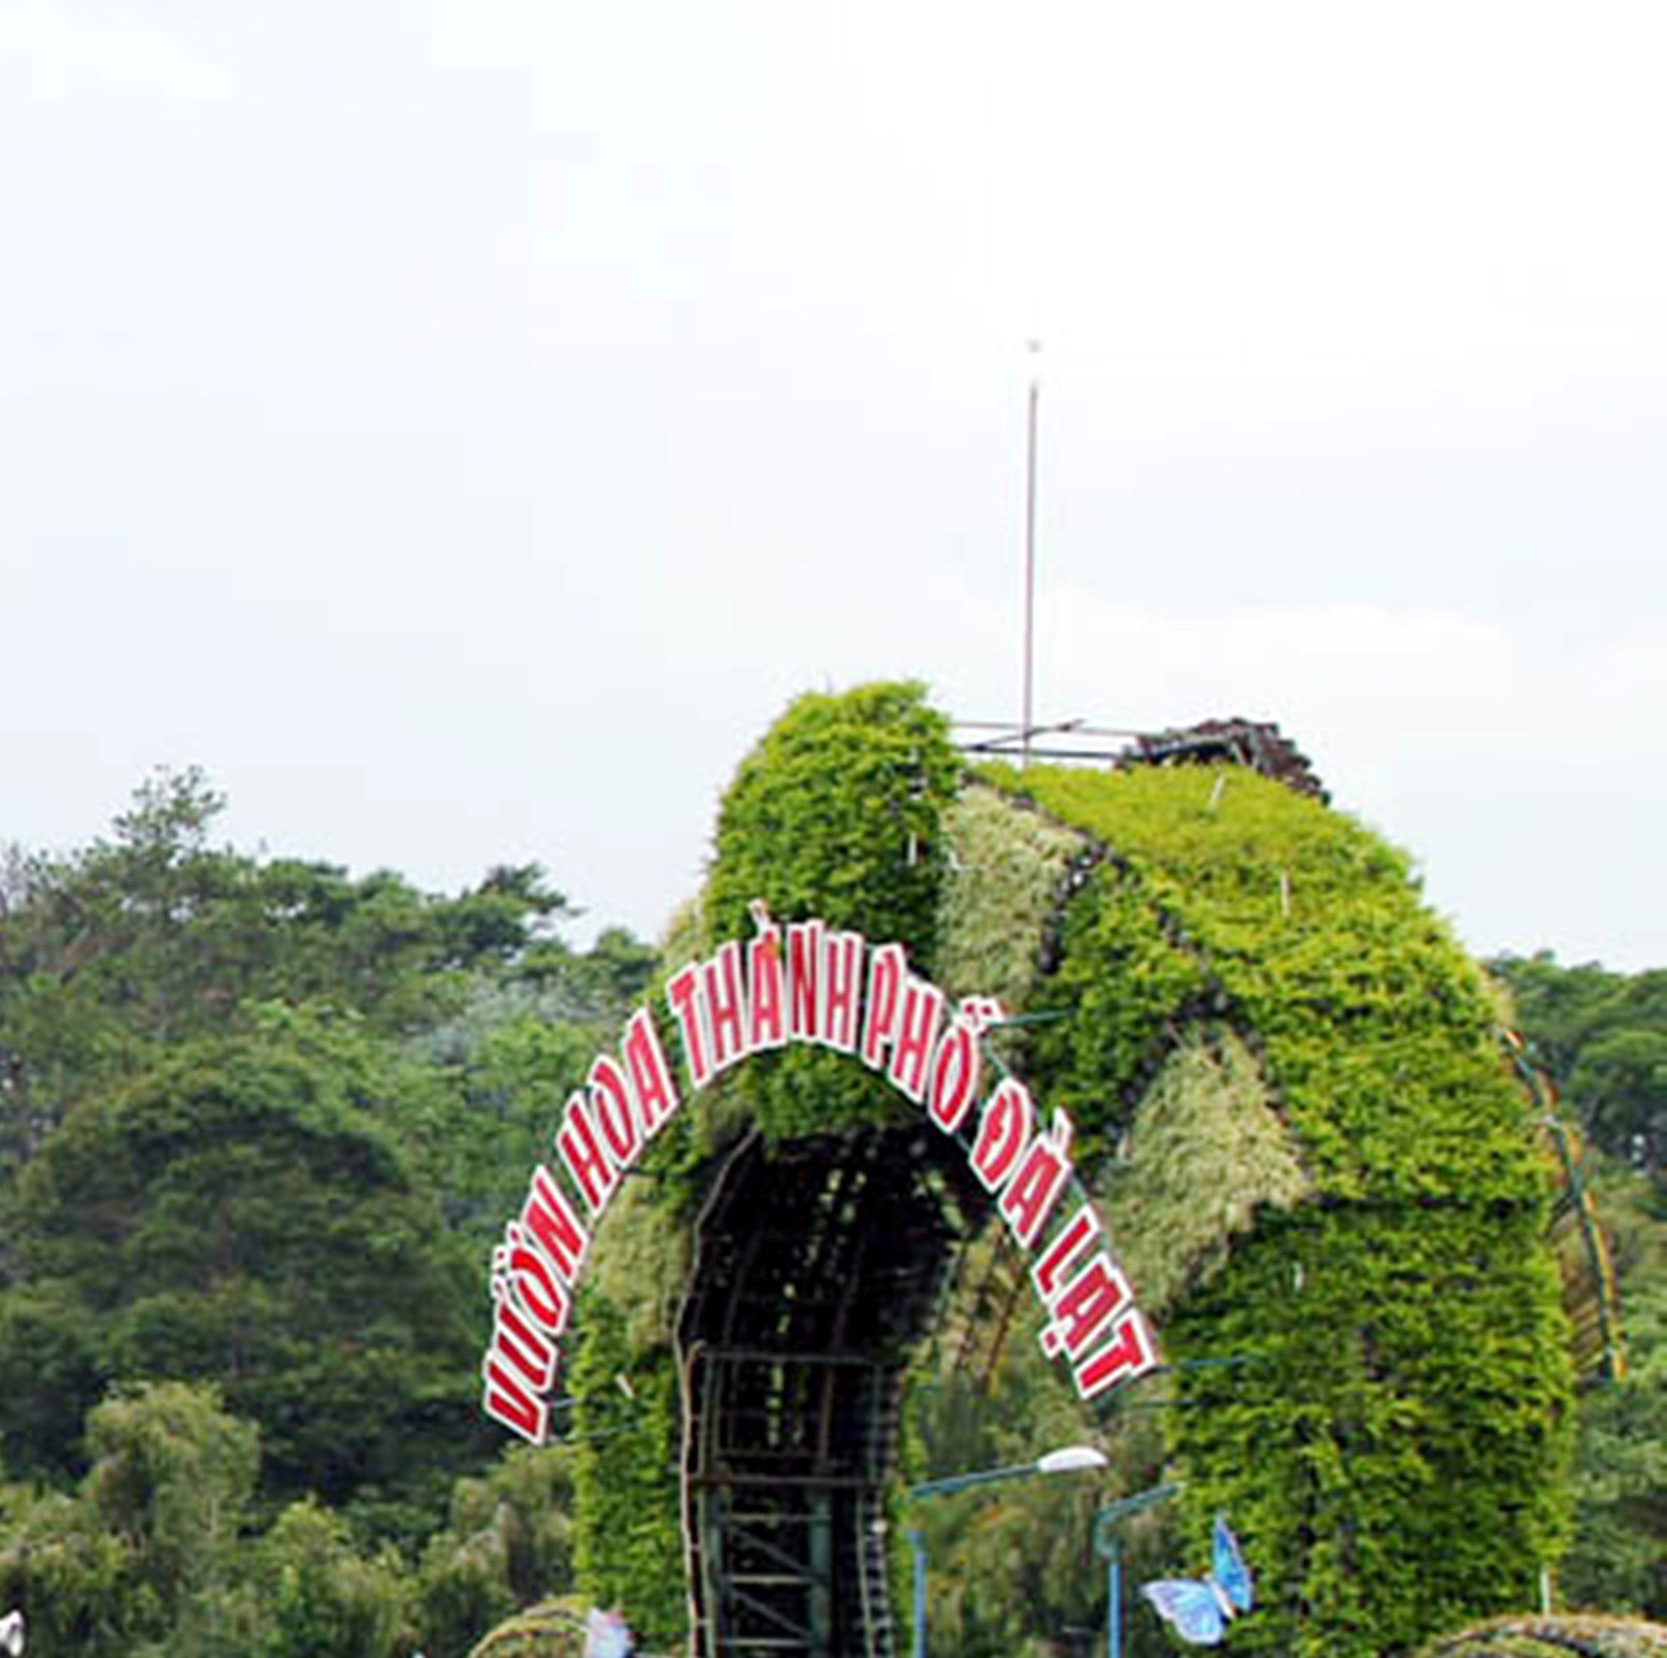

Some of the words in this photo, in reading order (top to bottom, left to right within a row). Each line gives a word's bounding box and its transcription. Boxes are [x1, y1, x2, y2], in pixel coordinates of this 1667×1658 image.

[481, 1164, 592, 1444] VƯỜN
[556, 1001, 679, 1218] HOA
[667, 898, 867, 1091] THÀNH
[862, 942, 1004, 1133] PHỐ
[969, 1076, 1073, 1249] ĐÀ
[1030, 1203, 1163, 1399] LẠT
